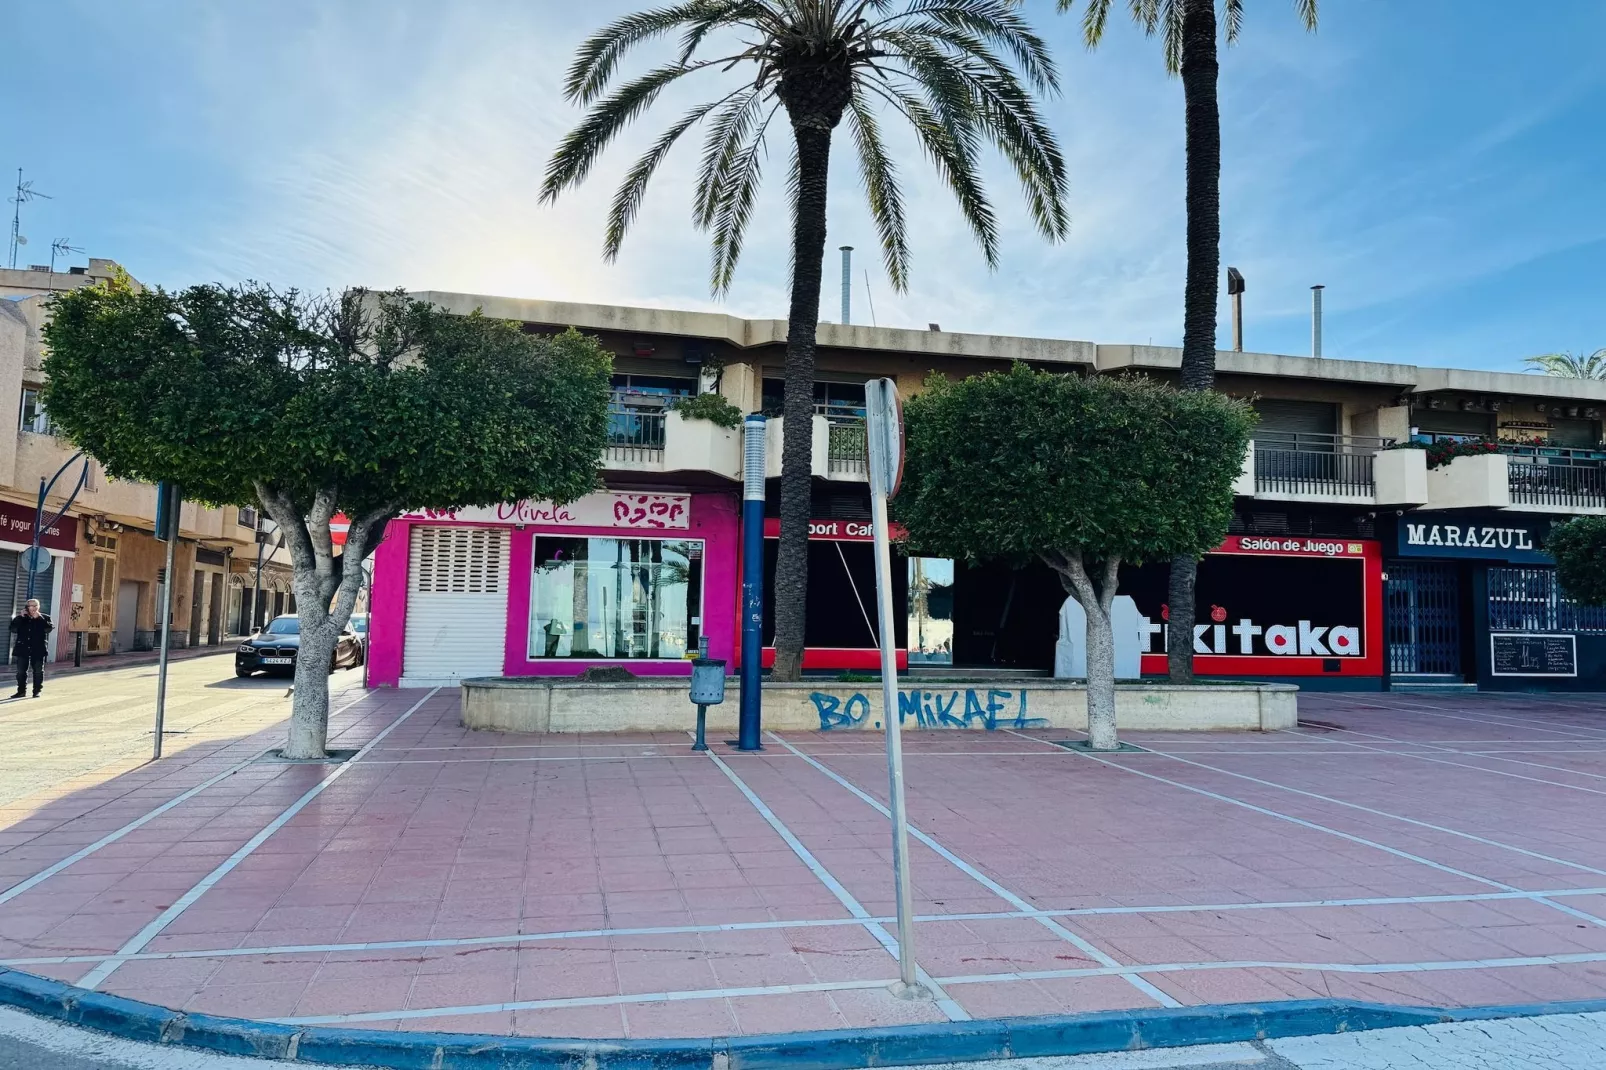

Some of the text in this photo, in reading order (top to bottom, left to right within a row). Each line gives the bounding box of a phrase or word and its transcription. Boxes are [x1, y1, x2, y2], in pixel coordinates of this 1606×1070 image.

[10, 518, 32, 532] yogur
[808, 522, 874, 536] port Caf
[1406, 523, 1533, 550] MARAZUL
[1241, 537, 1344, 556] Salón de Juego
